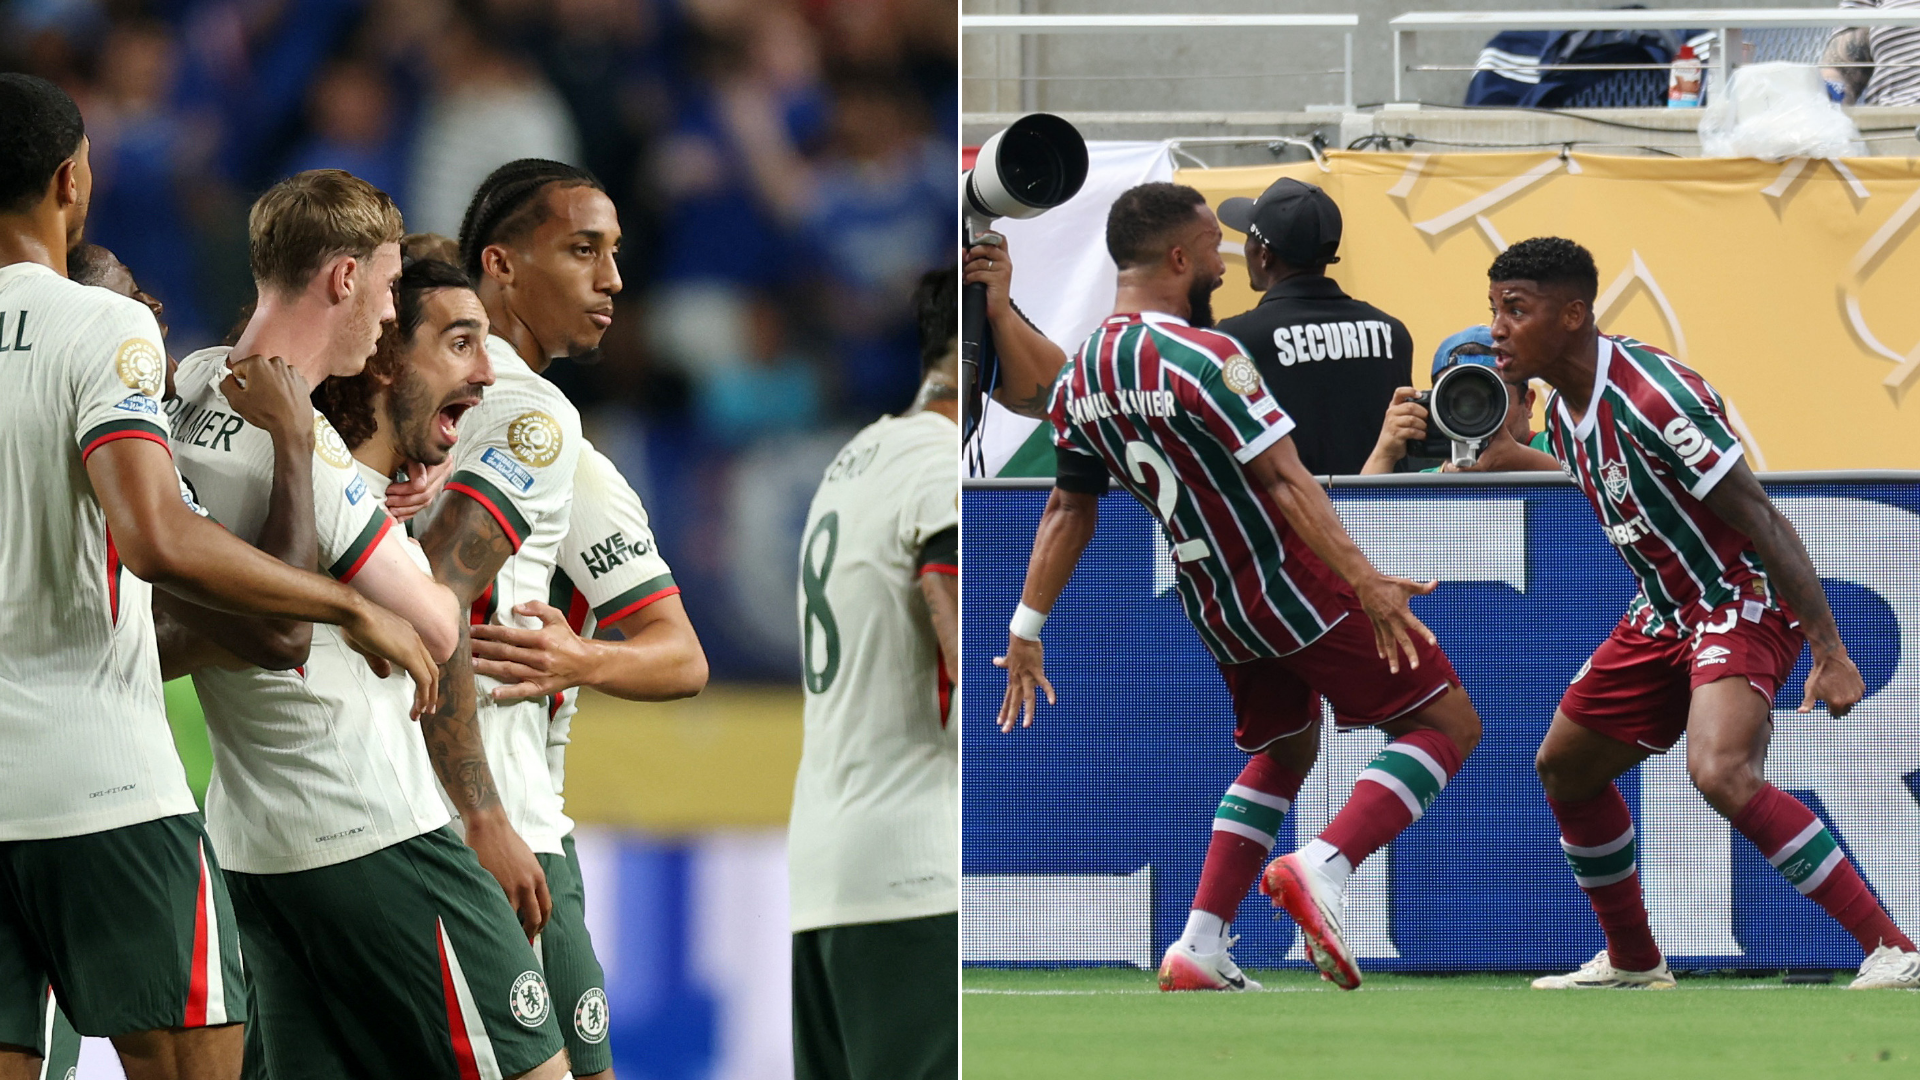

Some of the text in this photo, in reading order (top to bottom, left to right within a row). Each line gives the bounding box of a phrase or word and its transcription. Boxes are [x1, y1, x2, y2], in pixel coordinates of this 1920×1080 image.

[1273, 320, 1393, 367] SECURITY
[521, 416, 548, 424] WORLD
[515, 444, 535, 462] FIFA
[1125, 440, 1211, 563] 2
[580, 531, 627, 566] LIVE
[803, 510, 840, 694] 8
[1697, 658, 1727, 668] umbro
[513, 973, 537, 993] CHELSEA
[582, 989, 604, 1003] CHELSEA
